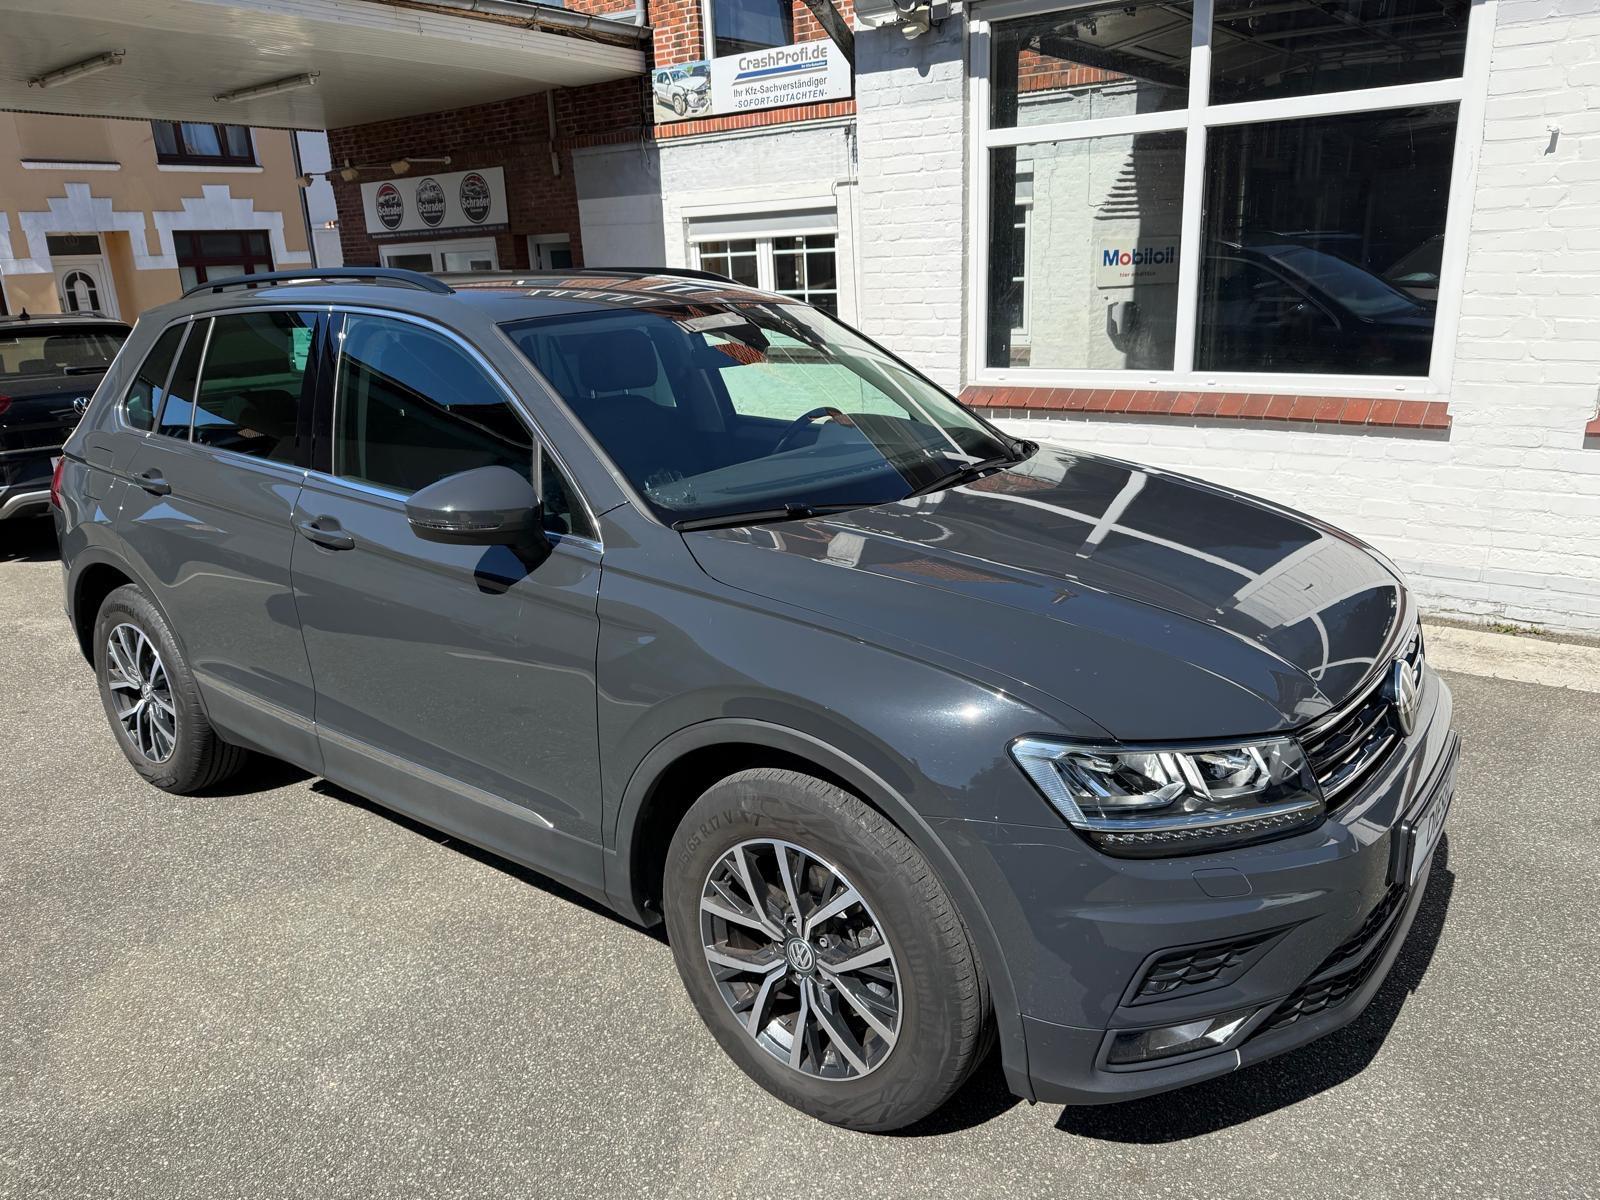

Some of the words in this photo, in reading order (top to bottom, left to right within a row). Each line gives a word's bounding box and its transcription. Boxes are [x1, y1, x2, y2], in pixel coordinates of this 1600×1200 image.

[738, 45, 828, 71] CrashProfi.de
[733, 88, 744, 98] Ihr
[745, 77, 827, 96] Kfz-Sachverständiger
[378, 205, 402, 216] Schrader
[418, 201, 445, 213] Schrader
[462, 196, 490, 209] Schrader
[1103, 246, 1175, 267] Mobiloil
